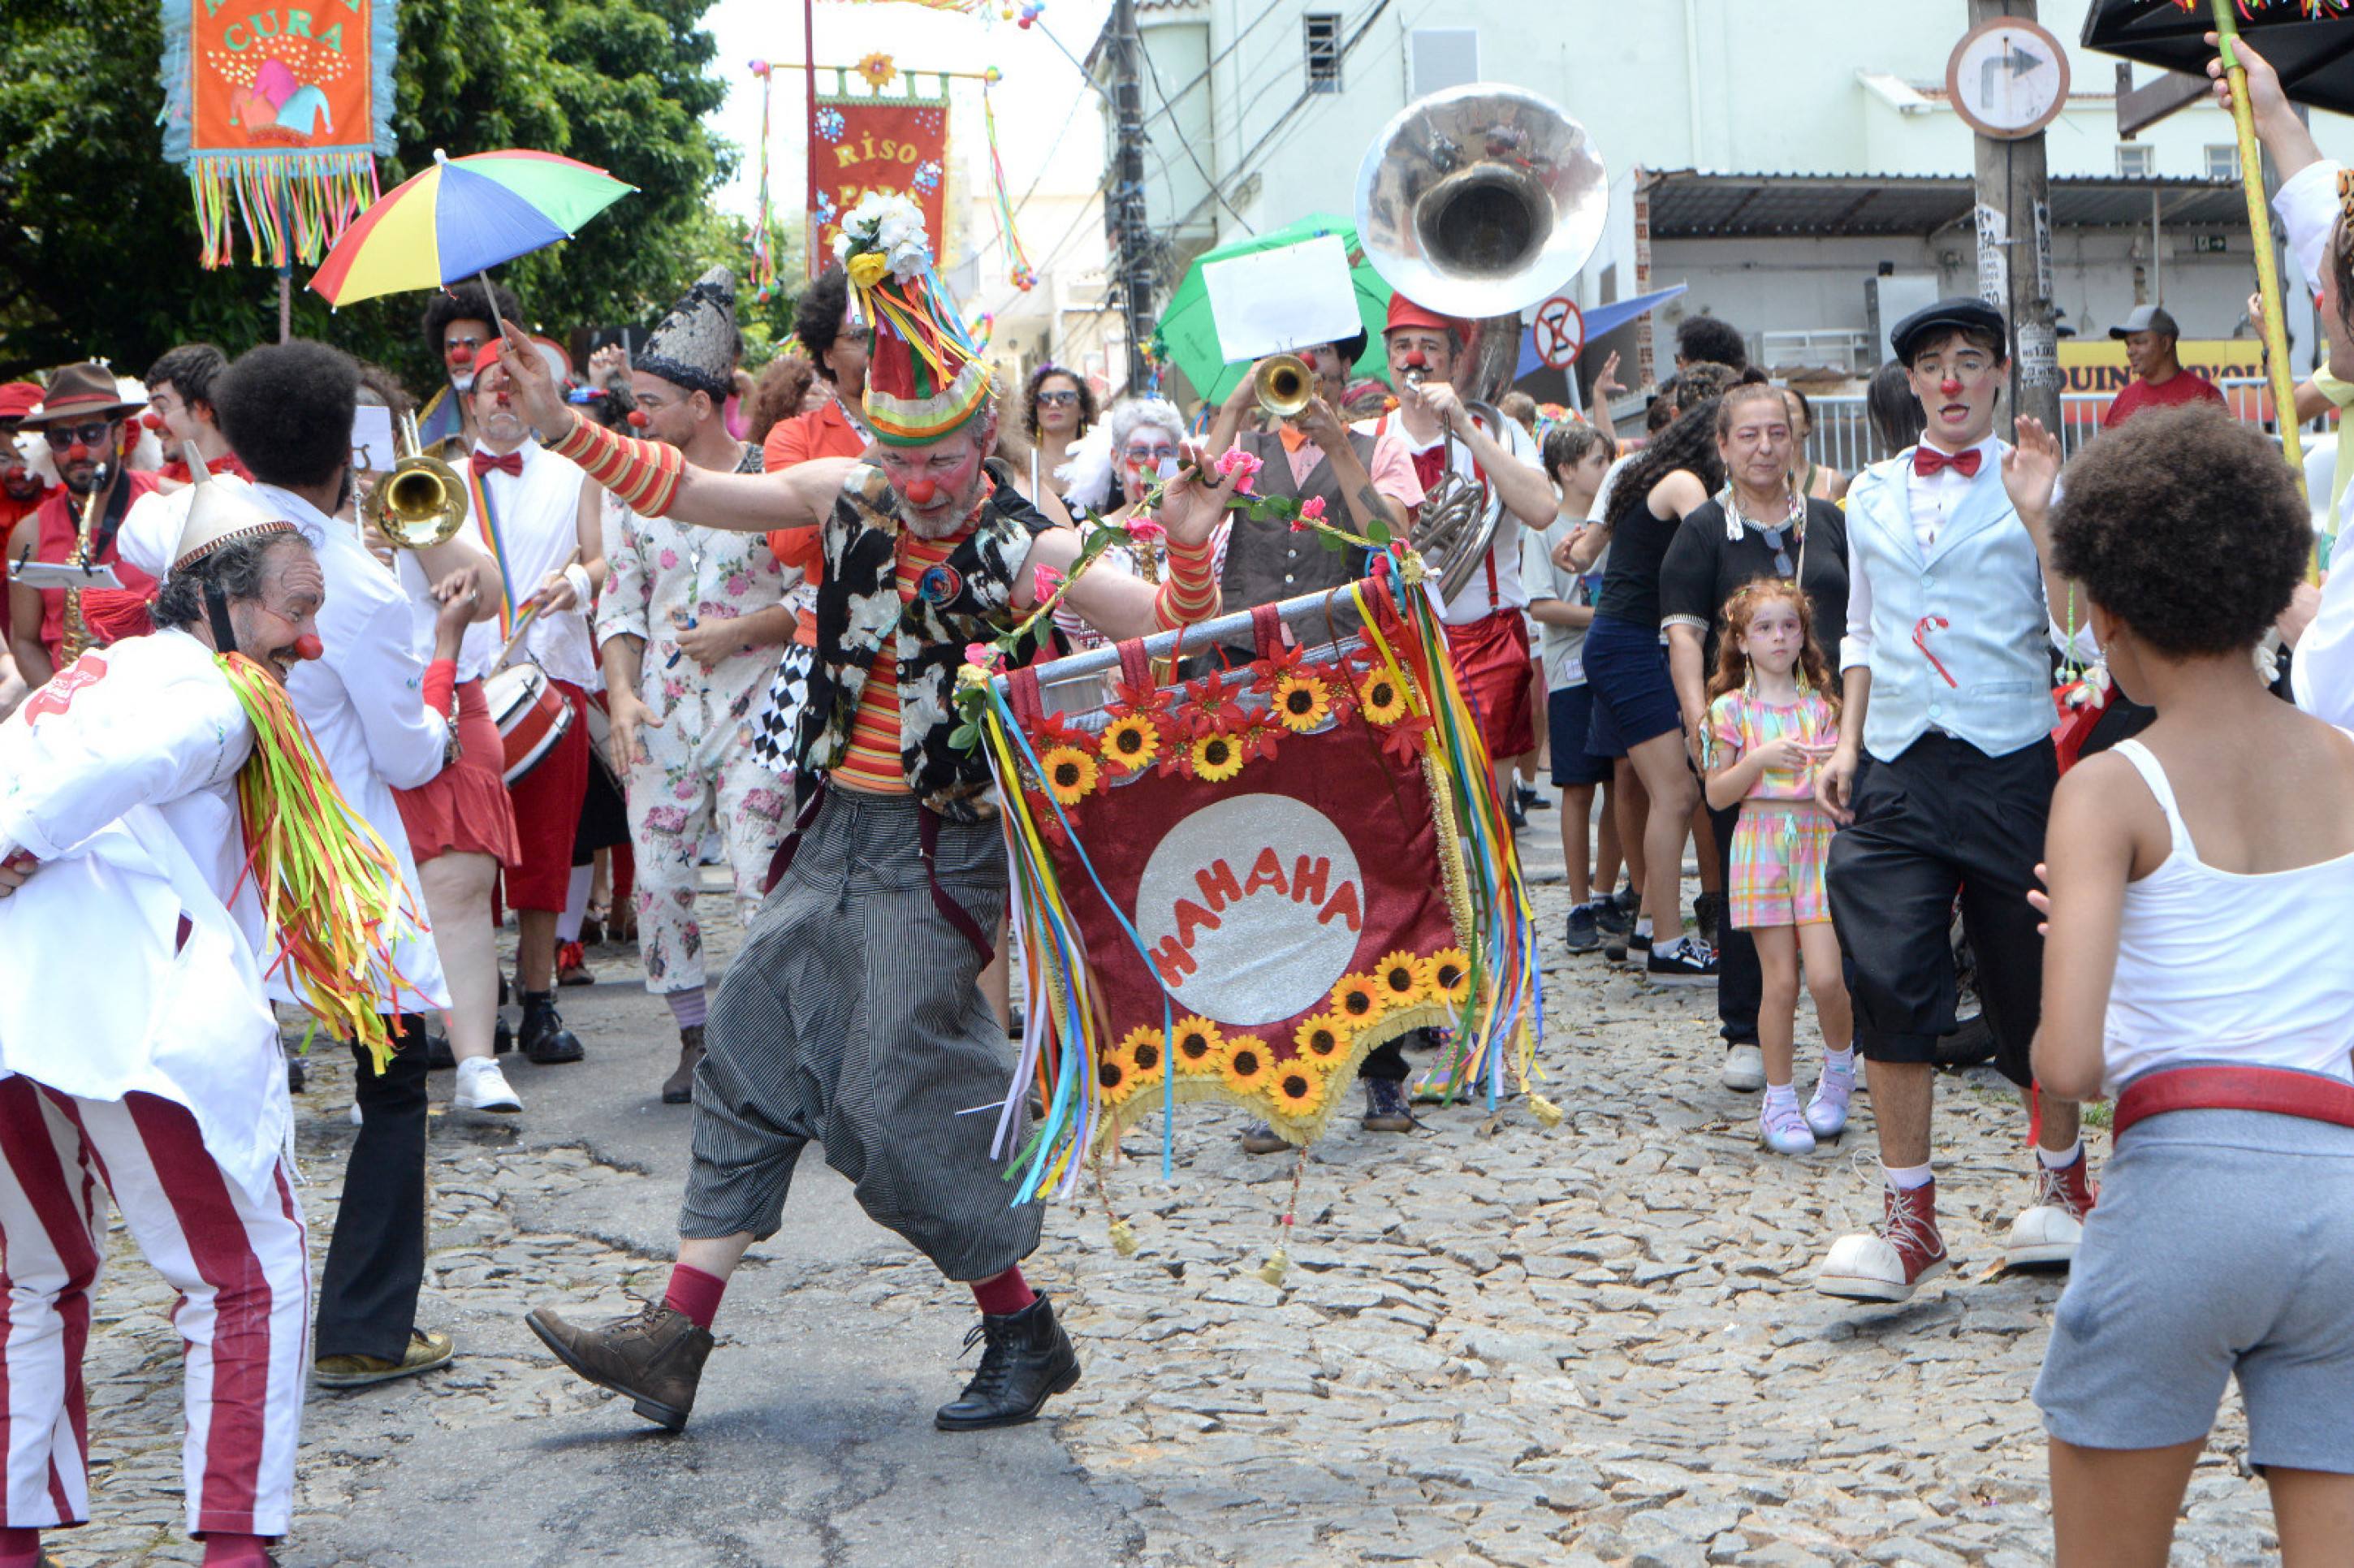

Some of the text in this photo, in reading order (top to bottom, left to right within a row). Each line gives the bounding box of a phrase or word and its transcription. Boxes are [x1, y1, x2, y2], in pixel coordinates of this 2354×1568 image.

[223, 8, 343, 53] CURA
[833, 130, 918, 168] RISO
[1147, 846, 1362, 988] HAHAHA
